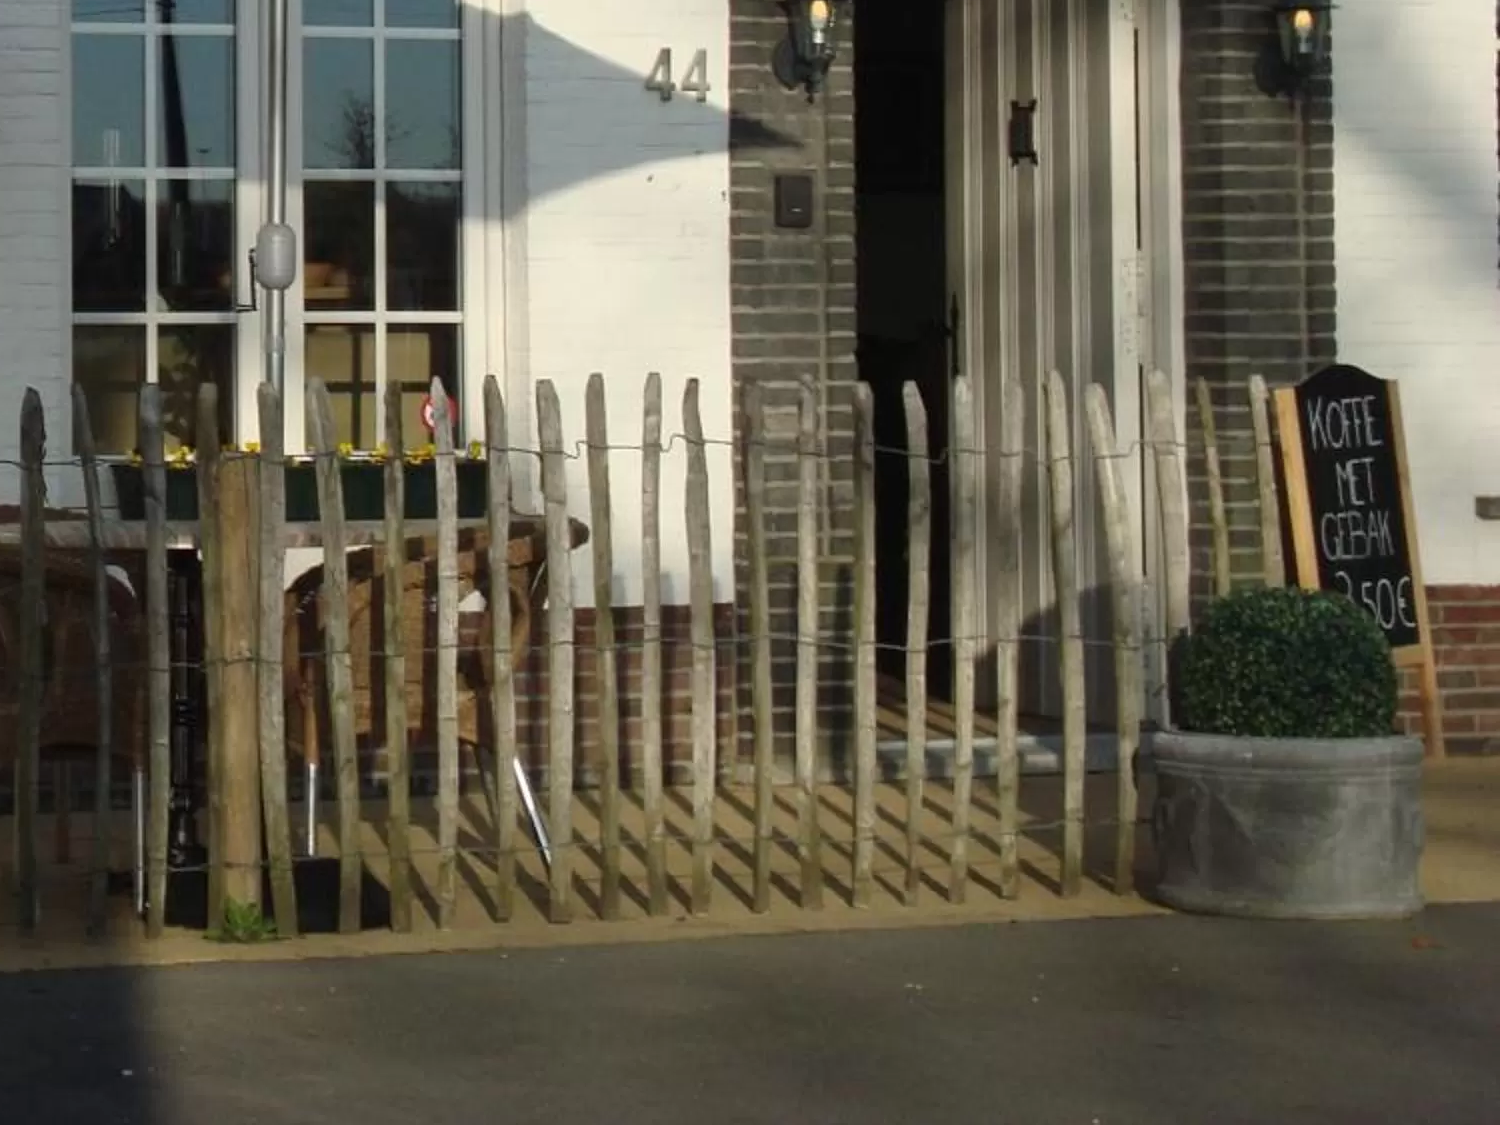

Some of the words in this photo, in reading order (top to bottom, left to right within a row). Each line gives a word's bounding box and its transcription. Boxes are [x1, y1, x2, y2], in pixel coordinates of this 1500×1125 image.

[644, 47, 711, 103] 44
[1336, 456, 1375, 507] MET
[1321, 511, 1394, 561] GEBAK
